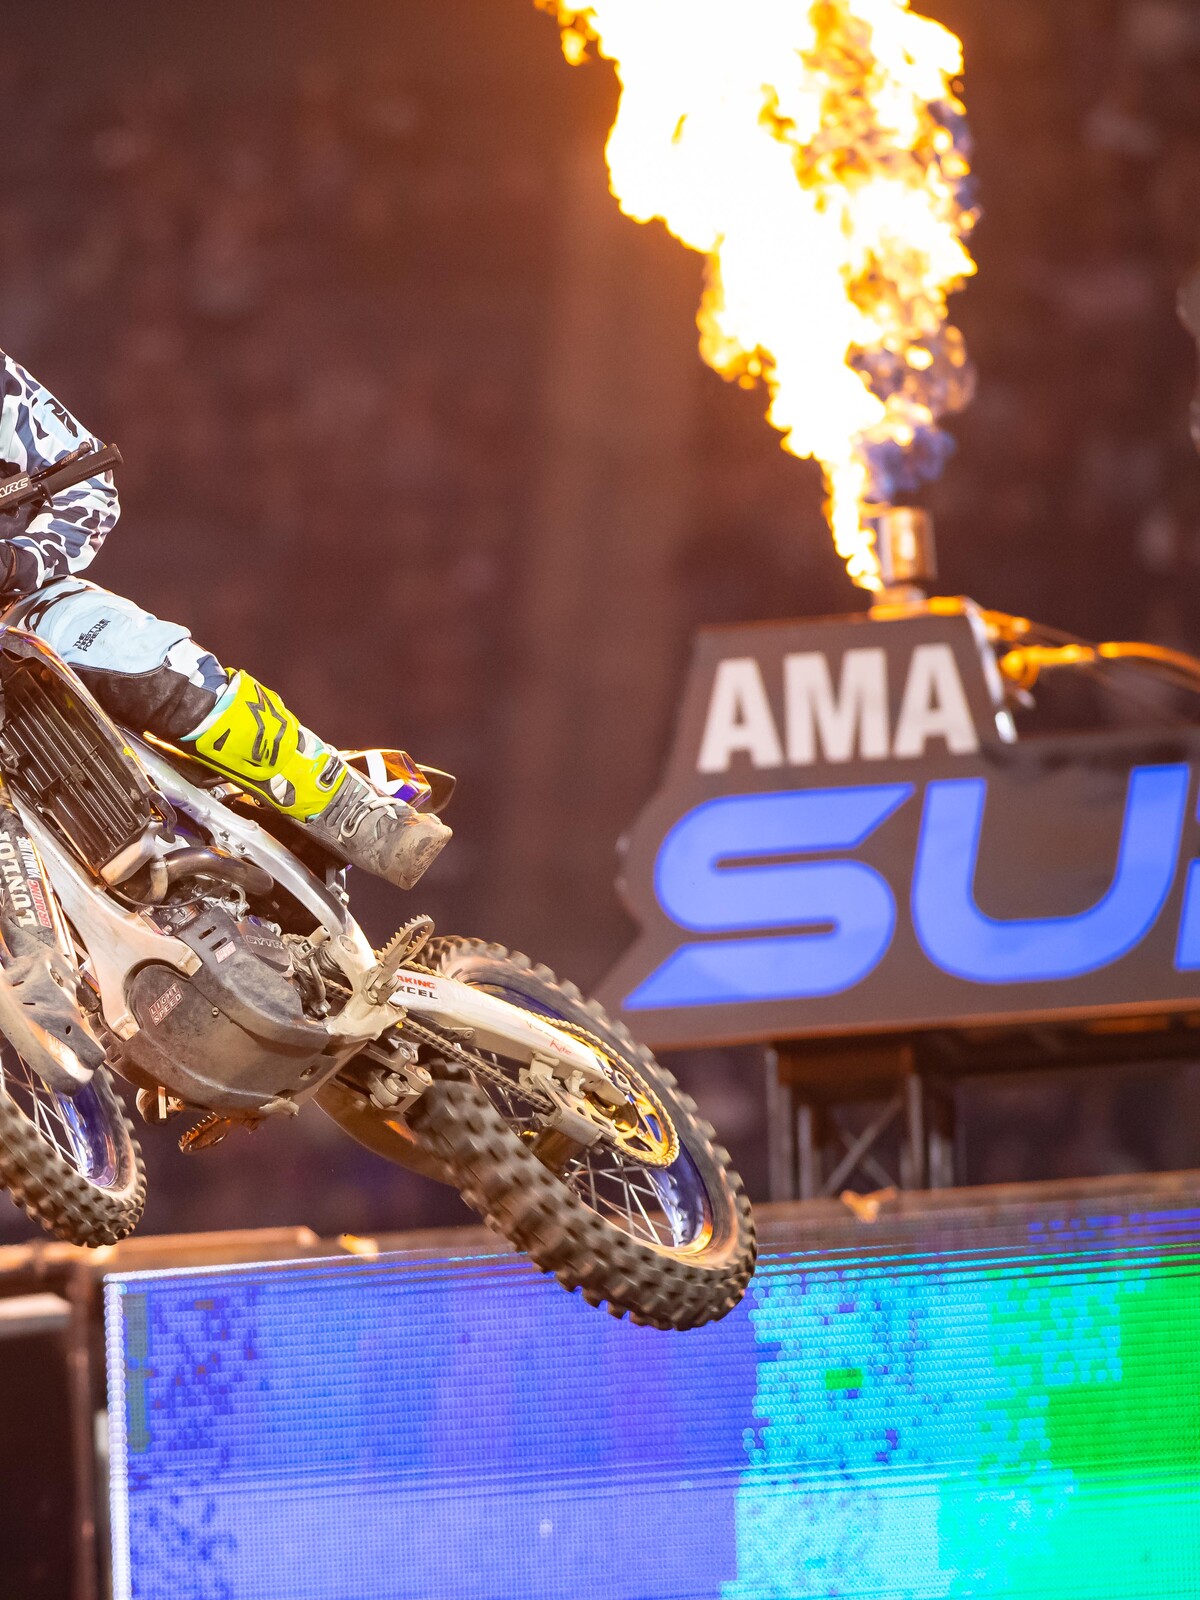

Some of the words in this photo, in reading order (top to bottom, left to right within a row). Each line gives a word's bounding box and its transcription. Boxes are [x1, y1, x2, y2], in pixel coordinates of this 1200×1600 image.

[698, 643, 979, 773] AMA
[622, 763, 1200, 1010] SU
[27, 879, 52, 928] BRAKING
[396, 985, 438, 999] XCEL
[397, 975, 436, 989] AKING
[150, 984, 179, 1015] LIGHT
[154, 994, 182, 1024] SPEED
